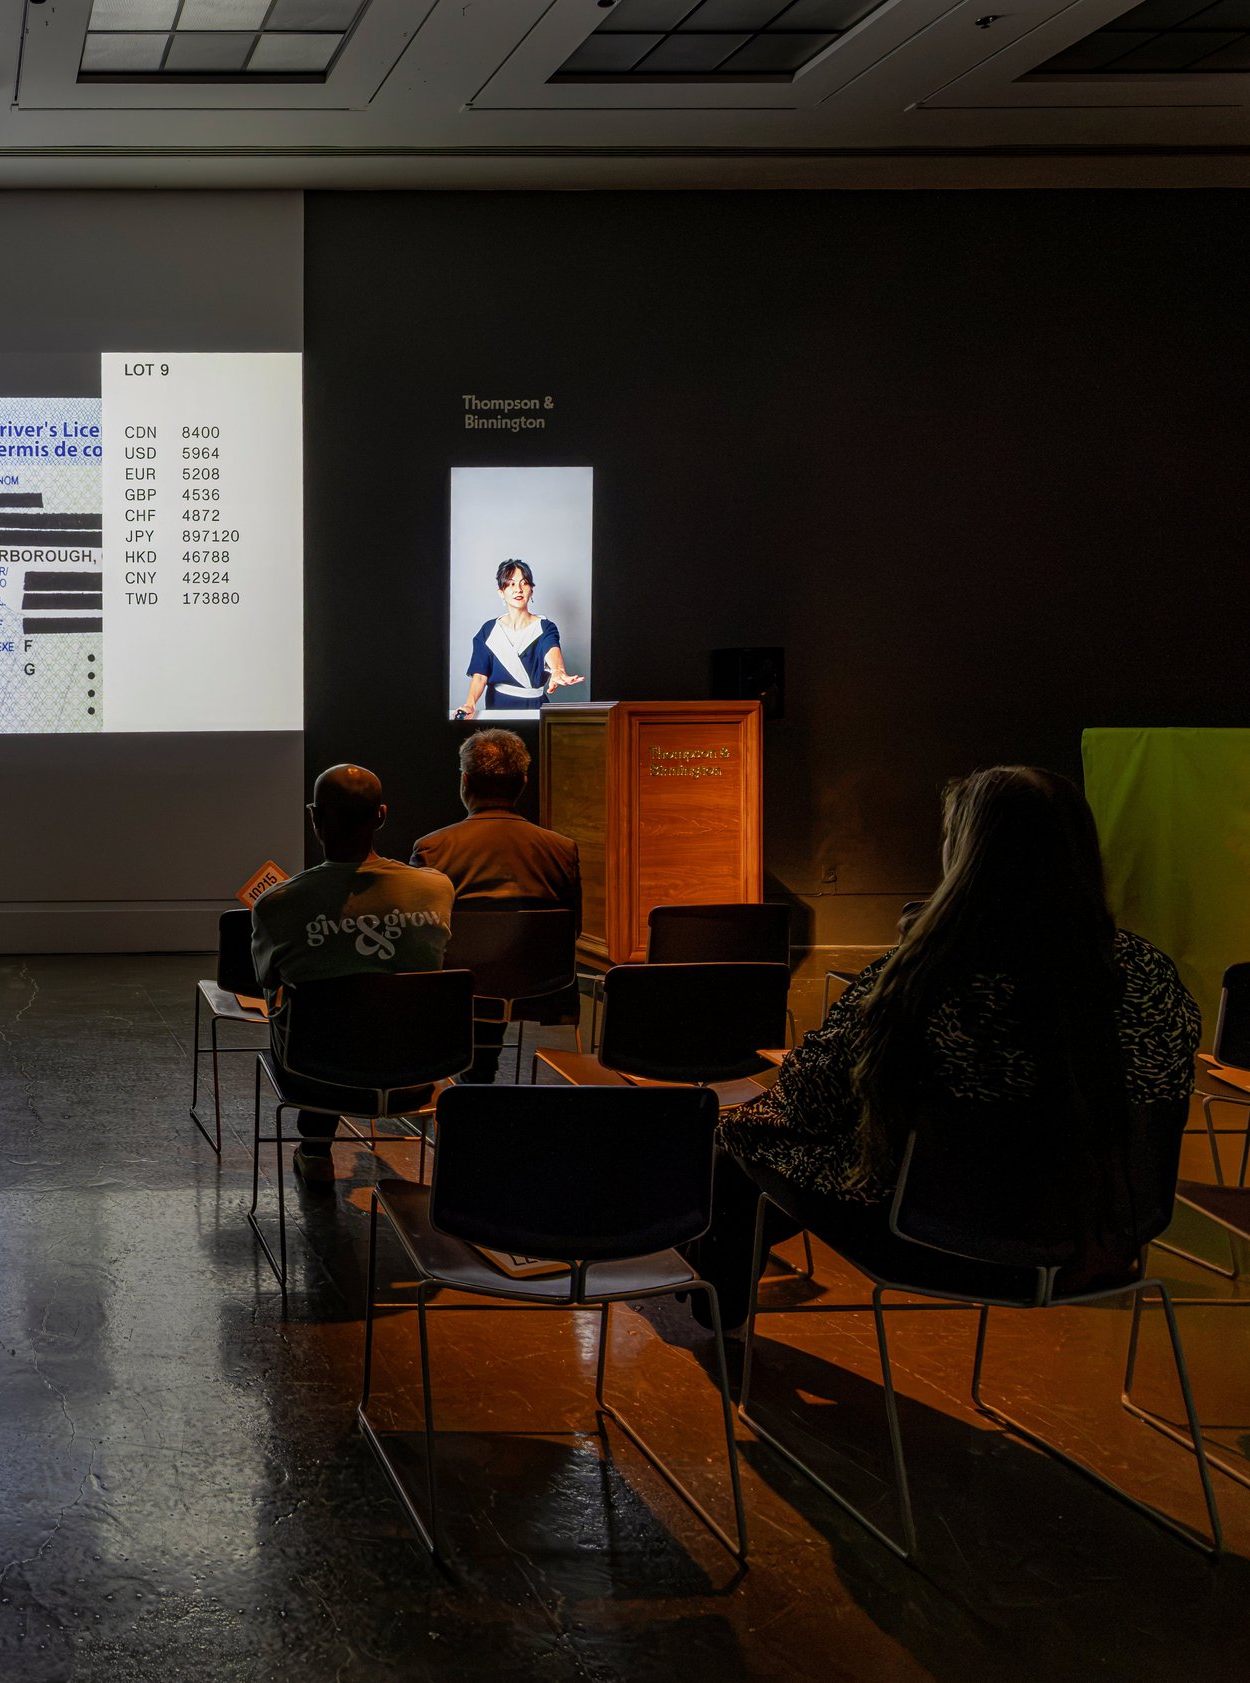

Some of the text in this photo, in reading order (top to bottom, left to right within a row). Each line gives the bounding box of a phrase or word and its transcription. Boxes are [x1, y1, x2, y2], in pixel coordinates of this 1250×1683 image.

[125, 364, 169, 376] LOT 9
[462, 395, 554, 413] Thompson &
[64, 421, 102, 437] Lice
[465, 414, 545, 432] Binnington
[125, 426, 219, 438] CDN 8400
[55, 440, 77, 457] de
[126, 447, 219, 459] USD 5964
[126, 468, 219, 480] EUR 5208
[125, 489, 219, 500] GBP 4536
[125, 510, 219, 521] CHF 4872
[126, 530, 239, 542] JPY 897120
[126, 551, 229, 563] HKD 46788
[126, 572, 229, 584] CNY 42924
[126, 592, 239, 604] TWD 173880
[24, 639, 33, 652] F
[24, 663, 36, 675] G
[306, 914, 357, 947] give
[384, 908, 441, 939] grow
